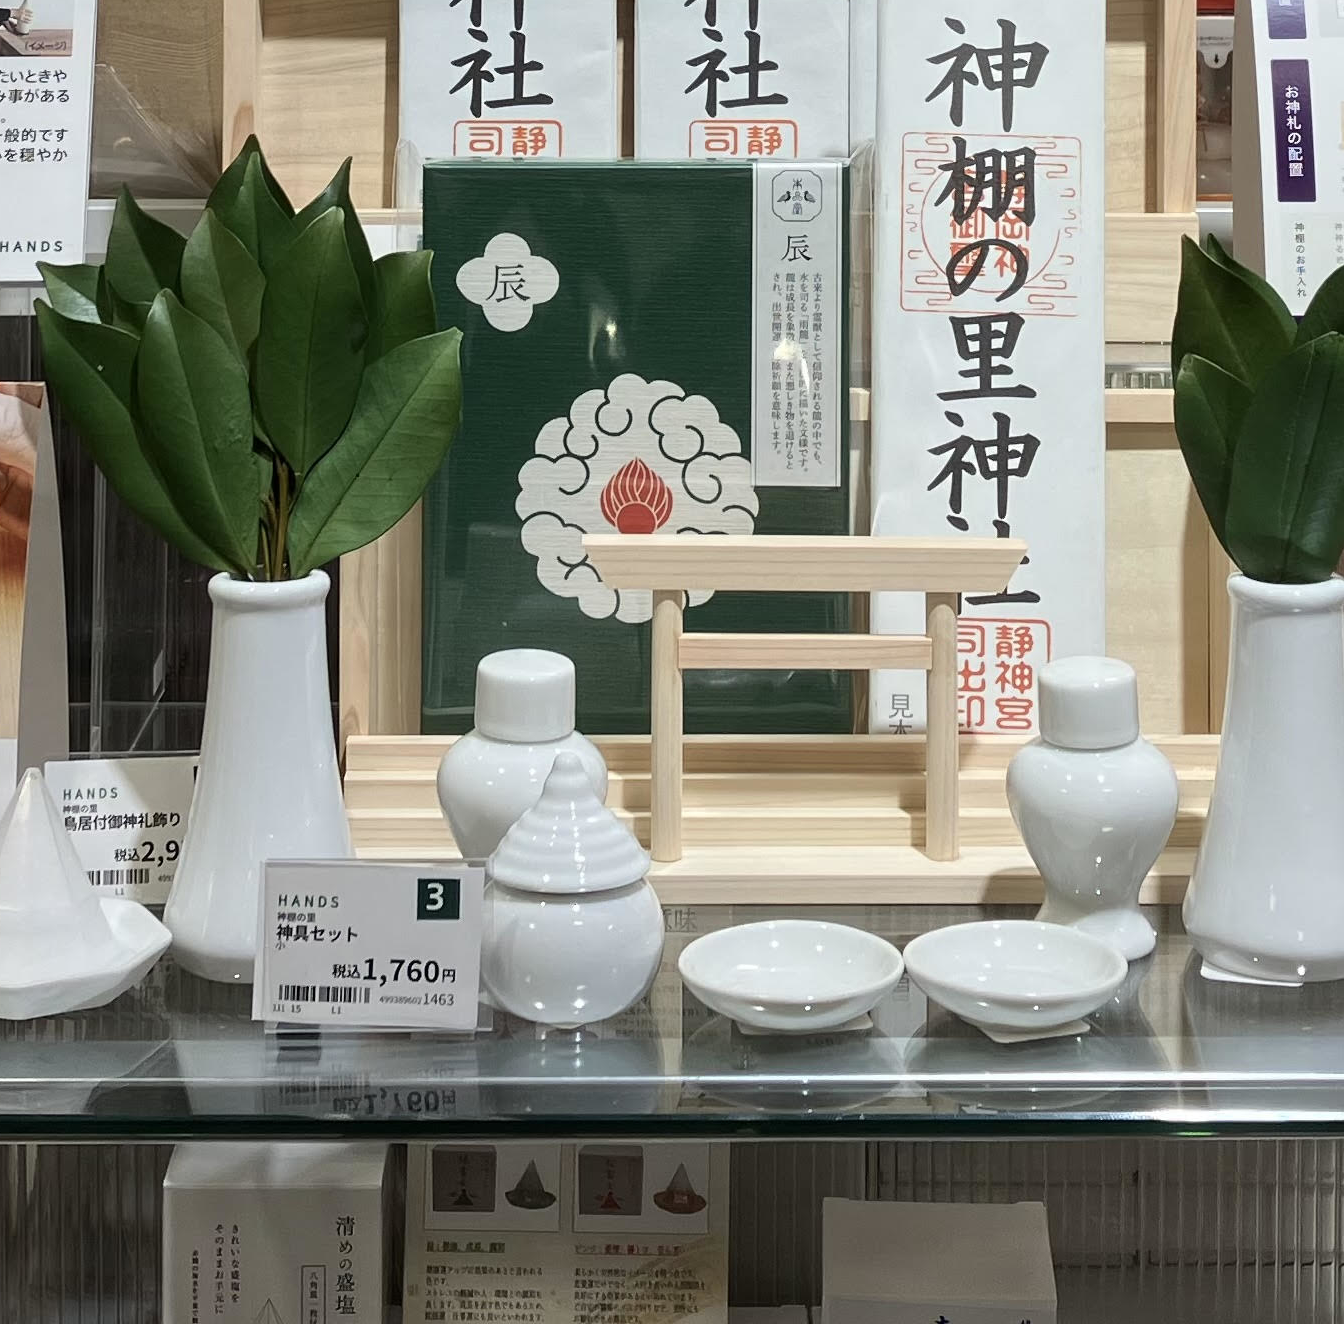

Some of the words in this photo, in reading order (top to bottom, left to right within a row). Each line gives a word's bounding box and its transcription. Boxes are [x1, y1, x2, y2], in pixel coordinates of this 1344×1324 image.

[1283, 85, 1306, 179] お神札の配置
[780, 233, 814, 263] 辰
[1294, 222, 1307, 298] 神棚のお手入れ
[484, 263, 532, 304] 辰
[62, 787, 119, 801] HANDS
[114, 839, 184, 867] 税込2,9
[277, 894, 340, 908] HANDS
[425, 882, 444, 911] 3
[276, 925, 359, 943] 神具セット
[331, 957, 457, 987] 税込1,760円
[334, 1215, 356, 1316] 清めの盛塩
